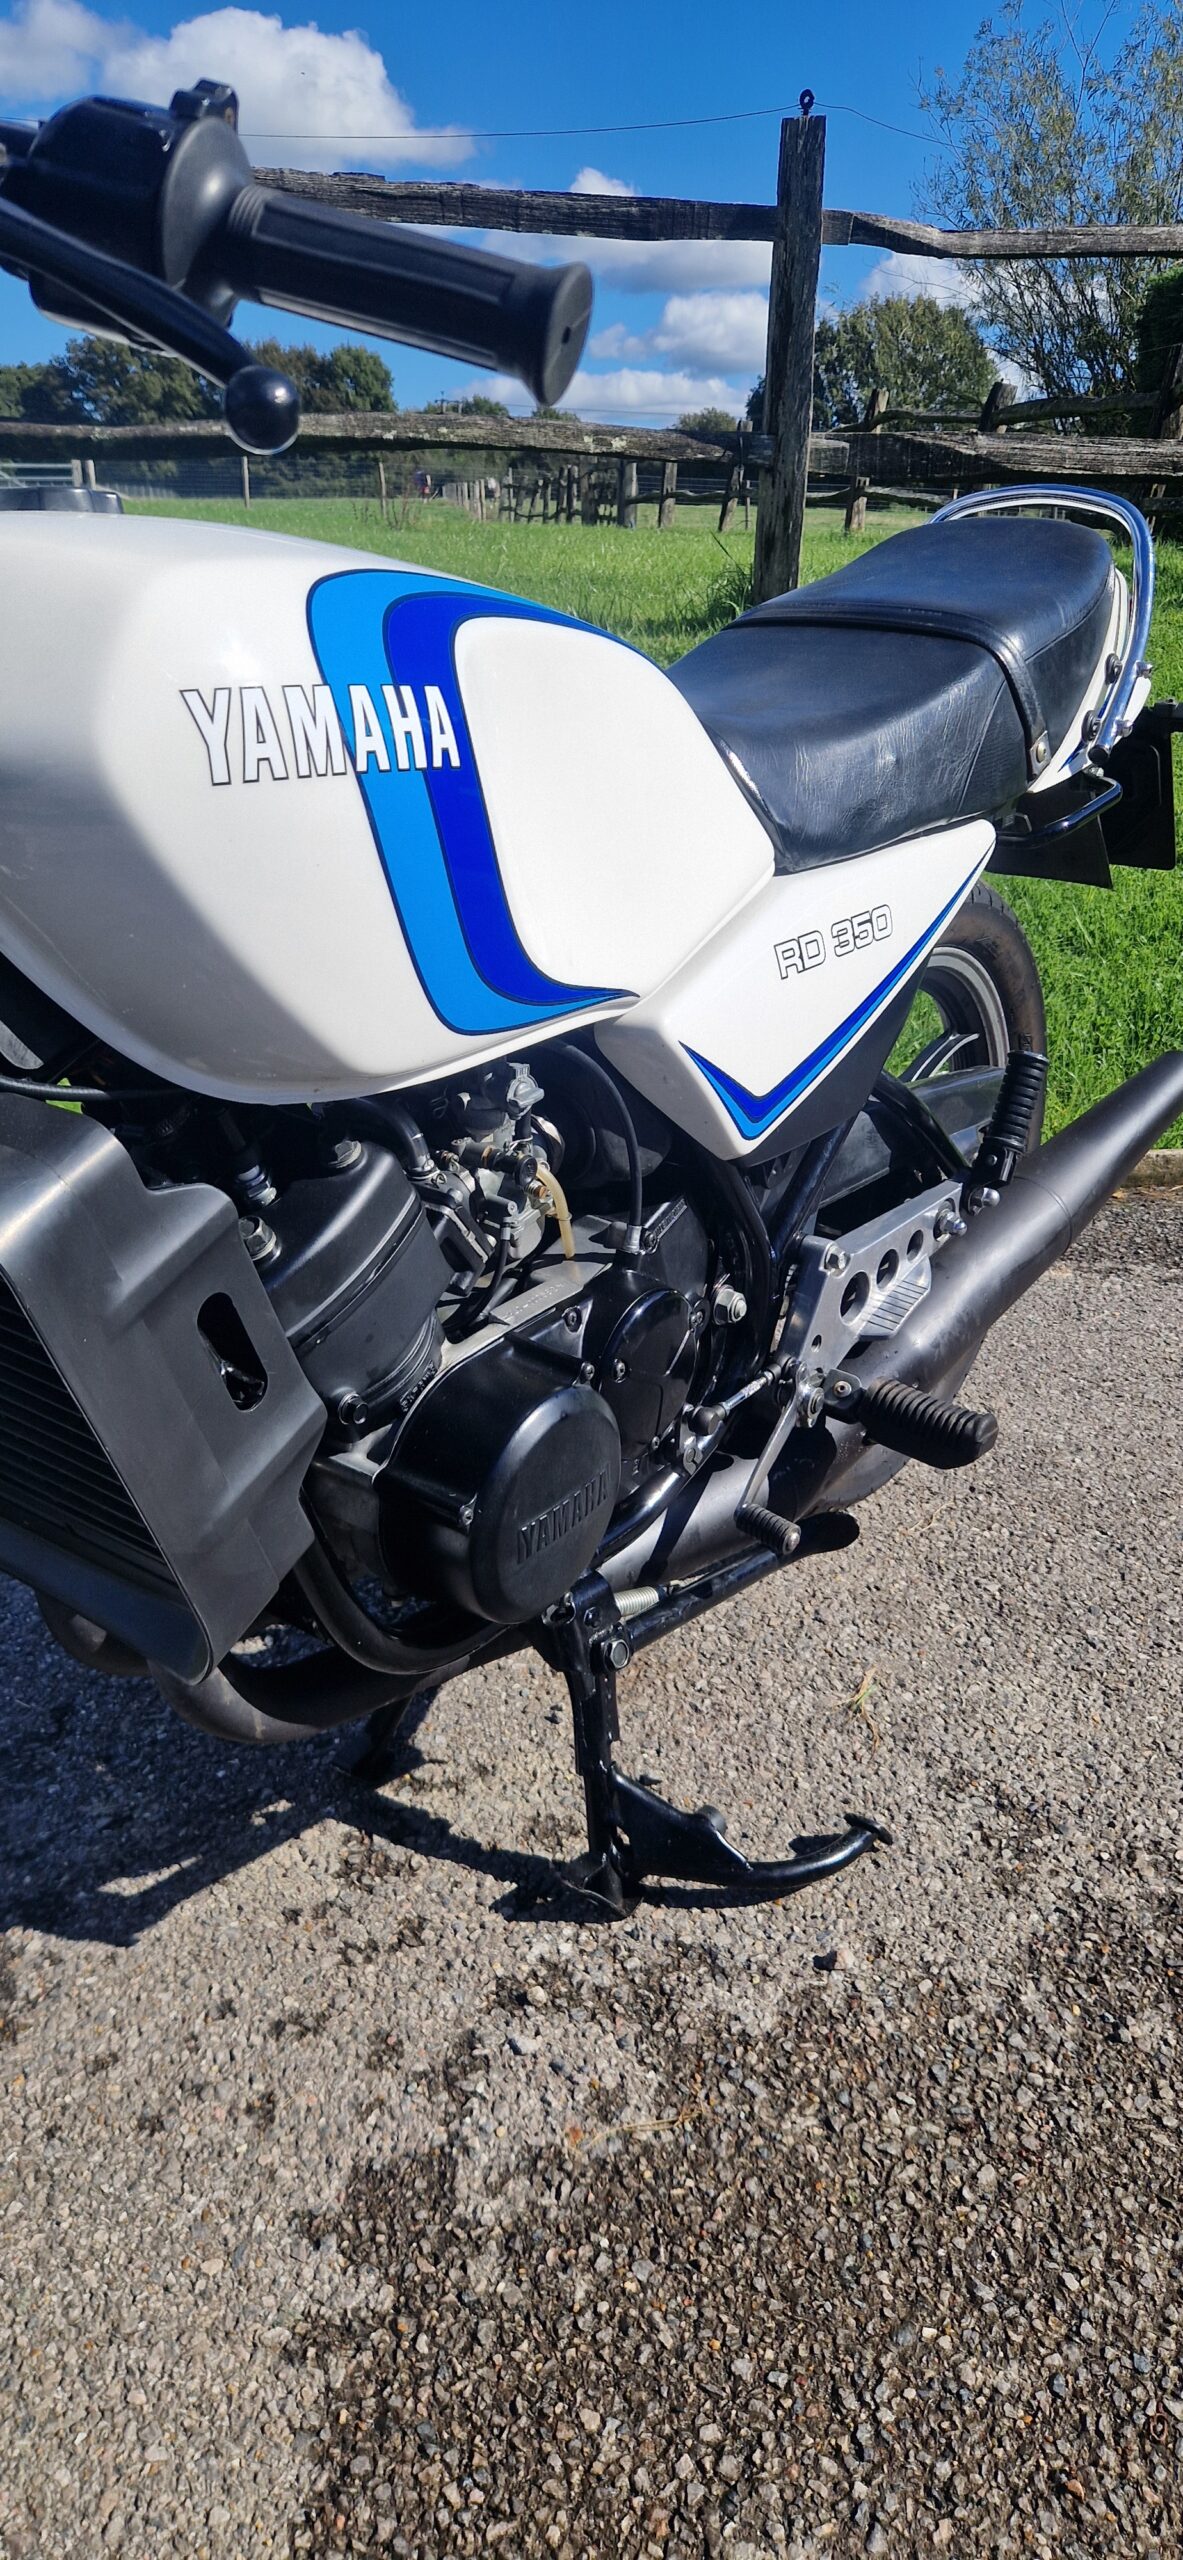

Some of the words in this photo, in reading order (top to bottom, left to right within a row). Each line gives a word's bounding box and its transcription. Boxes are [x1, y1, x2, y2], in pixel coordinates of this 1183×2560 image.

[179, 684, 461, 786] YAMAHA
[774, 930, 827, 980] RD
[831, 904, 893, 957] 350
[519, 1466, 610, 1562] YAMAHA
